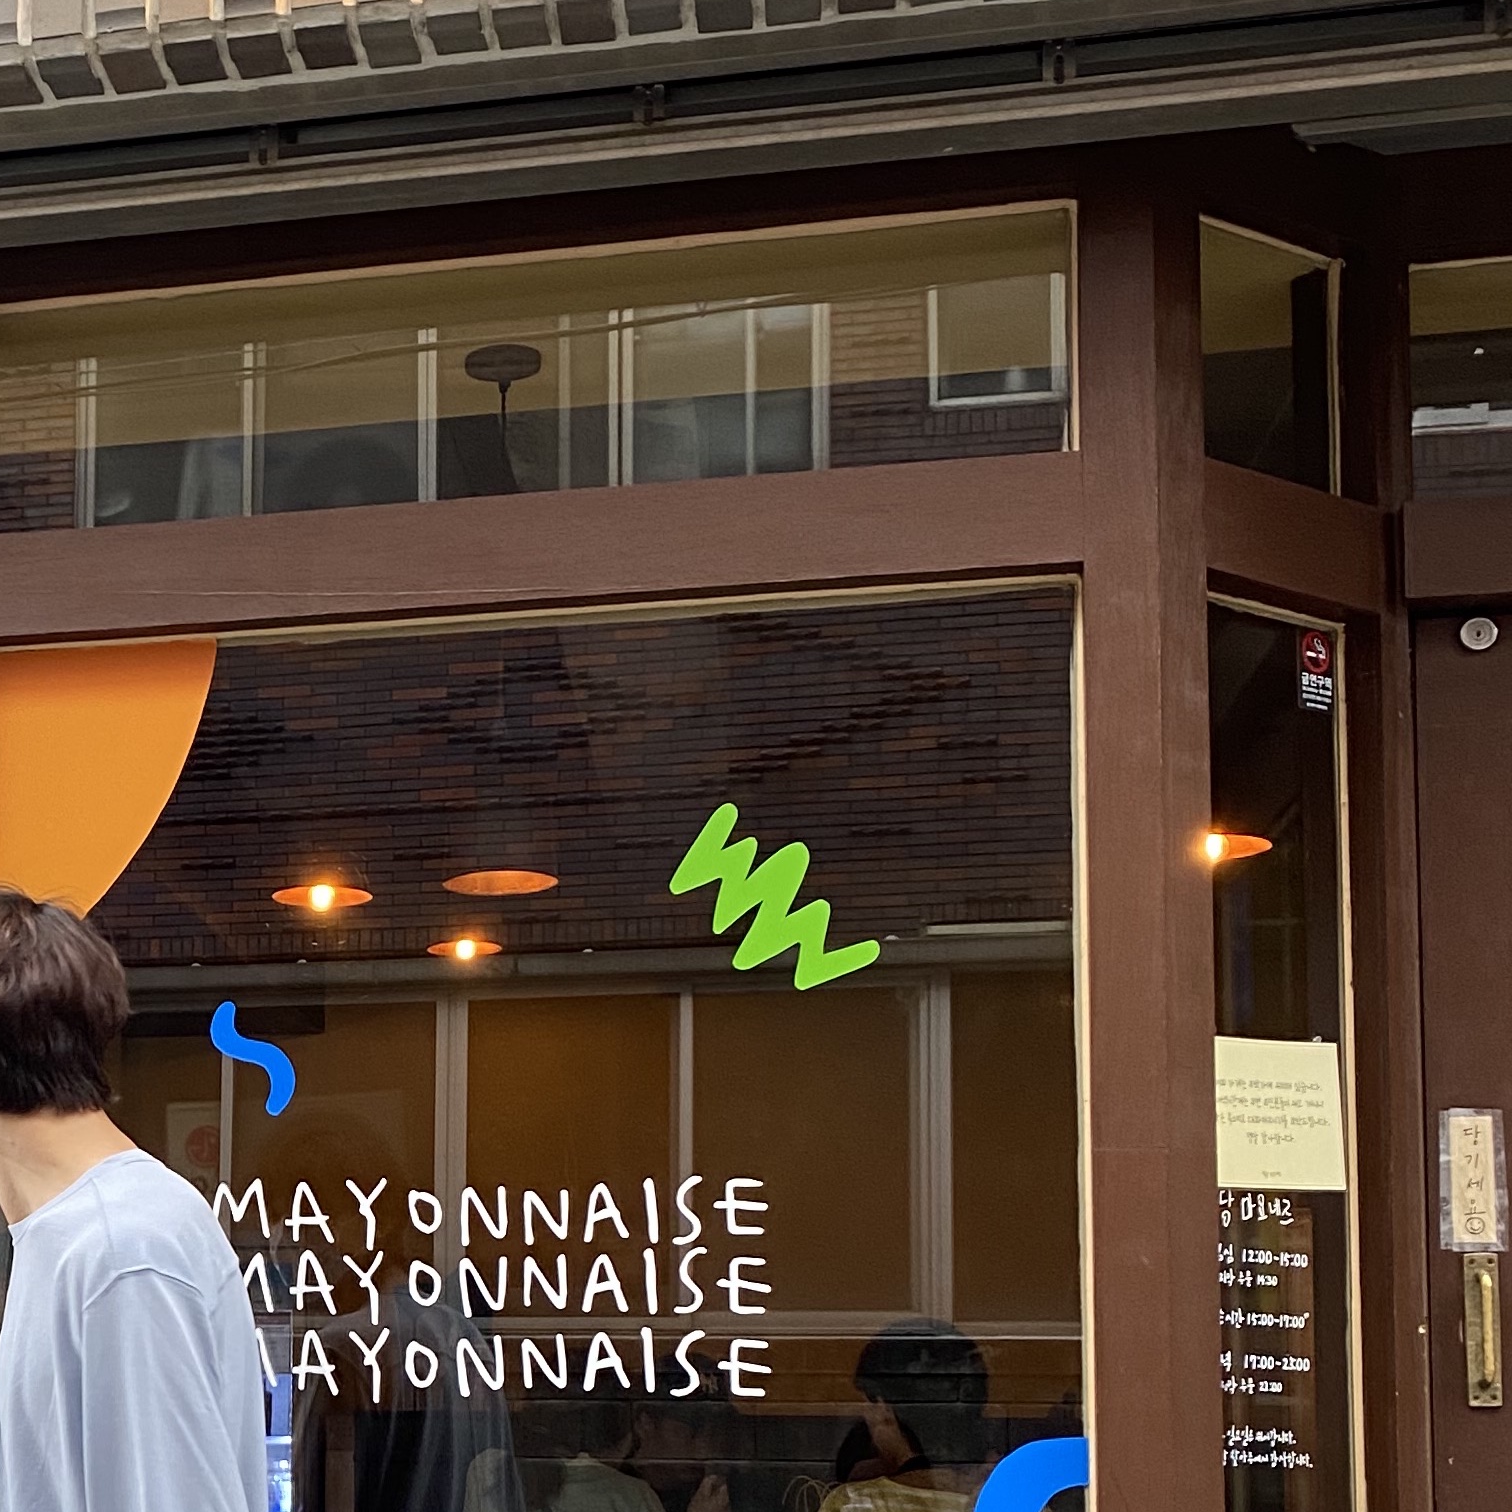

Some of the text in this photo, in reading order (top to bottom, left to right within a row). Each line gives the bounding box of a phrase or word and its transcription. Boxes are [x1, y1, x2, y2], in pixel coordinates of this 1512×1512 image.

[1463, 1125, 1487, 1216] 당기세요
[212, 1175, 769, 1250] MAYONNAISE
[1241, 1192, 1295, 1226] 마요네즈
[1237, 1269, 1254, 1288] 주문
[1241, 1248, 1309, 1268] 12:00-15:00
[255, 1326, 772, 1403] AYONNAISE
